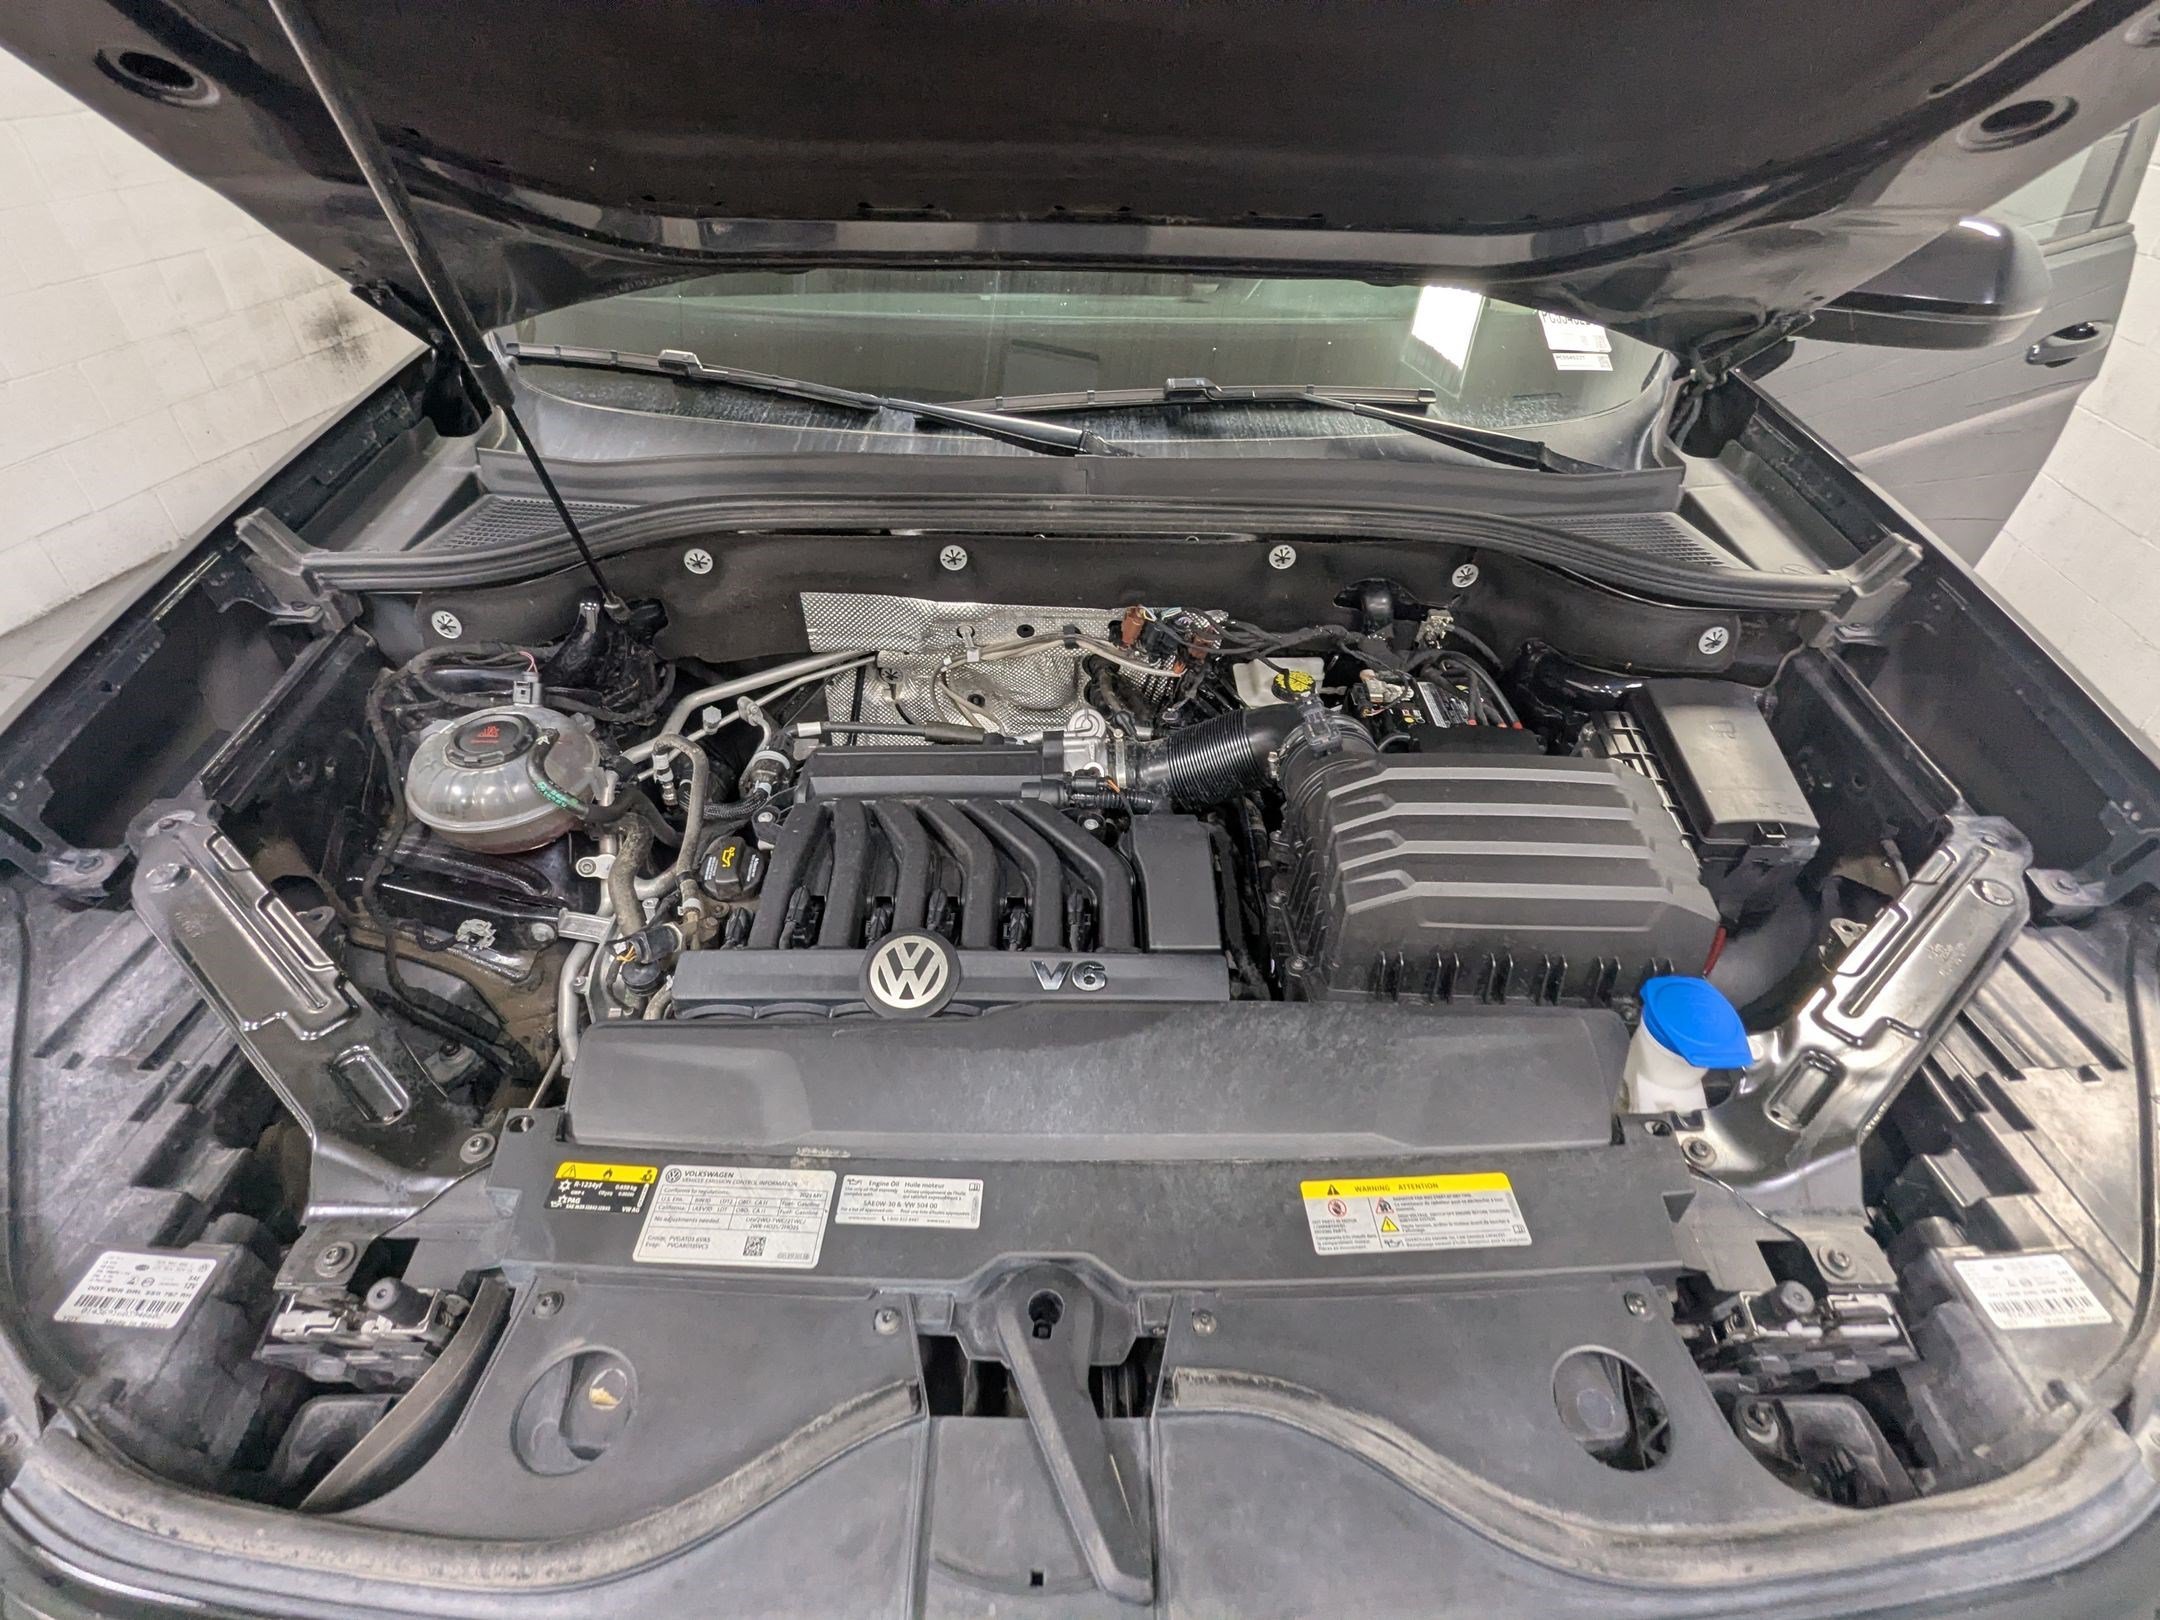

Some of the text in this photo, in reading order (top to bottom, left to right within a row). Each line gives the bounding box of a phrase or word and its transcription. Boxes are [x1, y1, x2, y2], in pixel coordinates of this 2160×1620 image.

[1030, 960, 1106, 991] V6
[684, 1170, 734, 1178] VOLKSWAGEN
[868, 1180, 890, 1188] Engine
[1353, 1182, 1439, 1193] WARNING ATTENTION
